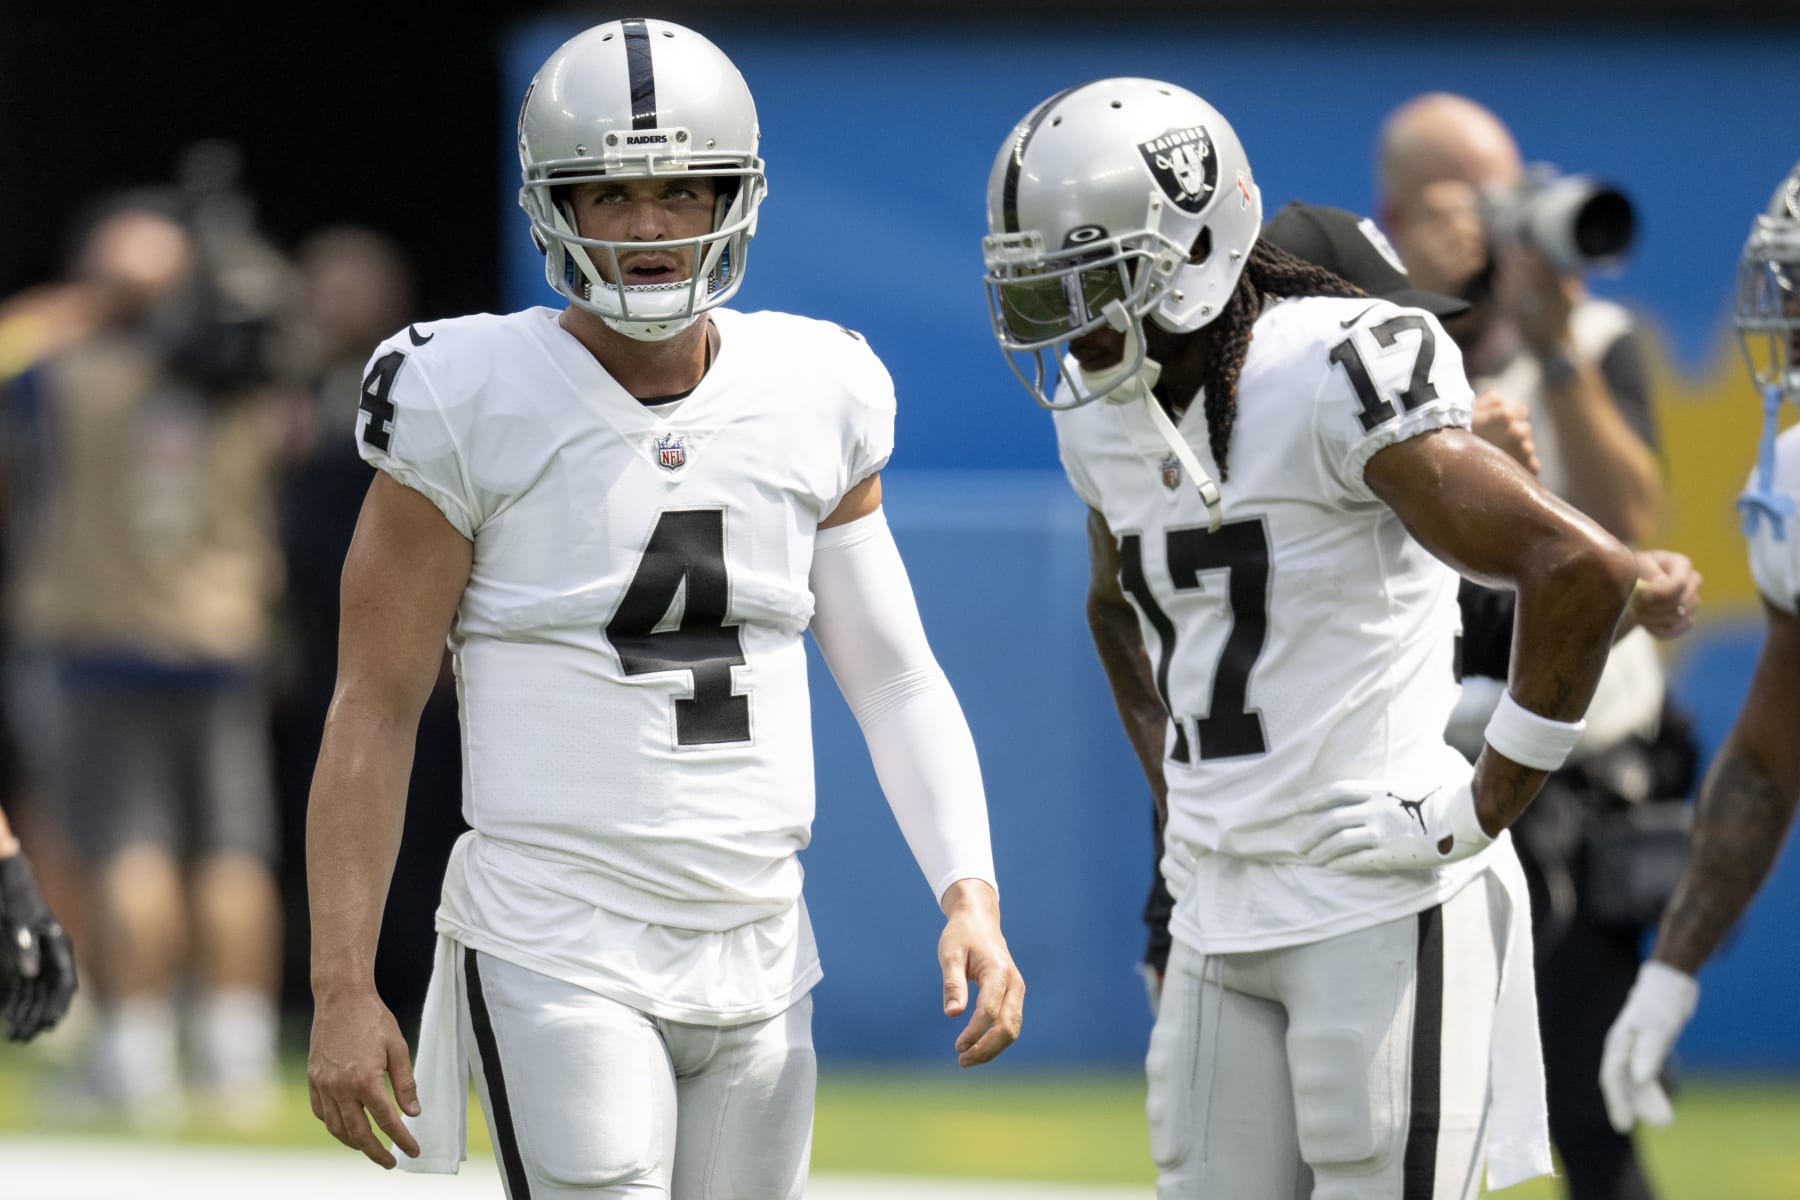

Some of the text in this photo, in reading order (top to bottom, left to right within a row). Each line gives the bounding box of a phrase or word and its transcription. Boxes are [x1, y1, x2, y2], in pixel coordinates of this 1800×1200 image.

[626, 134, 667, 145] RAIDERS
[359, 350, 406, 452] 4
[1329, 315, 1440, 432] 17
[662, 450, 683, 465] NFL
[604, 508, 752, 746] 4
[1118, 516, 1271, 764] 17
